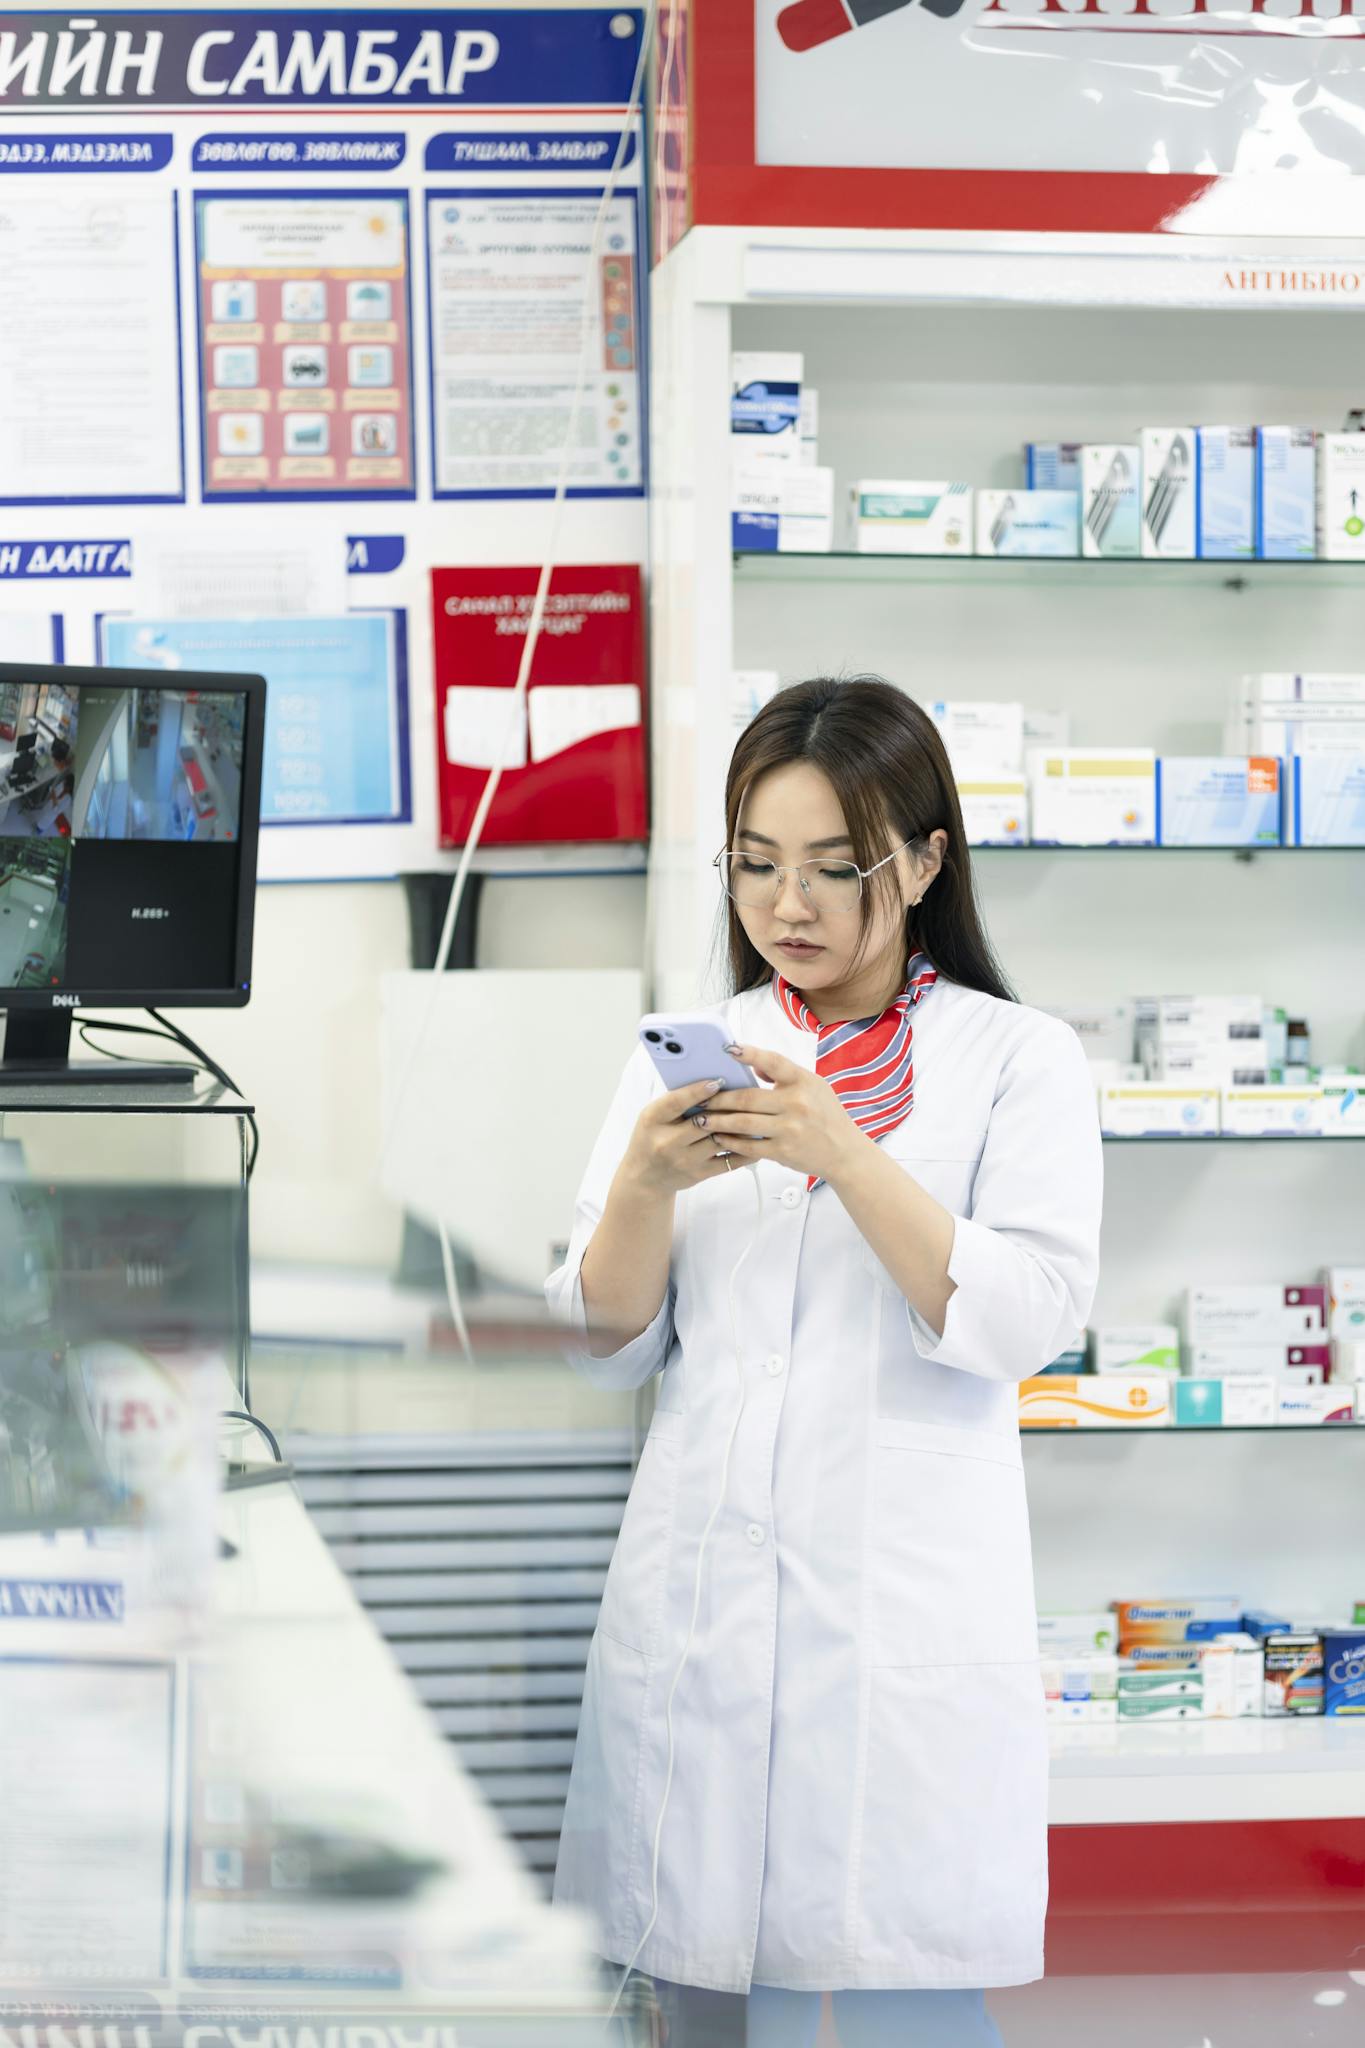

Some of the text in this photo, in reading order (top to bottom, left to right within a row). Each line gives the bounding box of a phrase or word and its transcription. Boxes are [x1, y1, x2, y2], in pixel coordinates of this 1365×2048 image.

[186, 30, 500, 95] САМБАР
[51, 143, 153, 163] МЭДЭЭЛЭЛ
[131, 907, 170, 919] H.265+
[52, 994, 81, 1007] DELL
